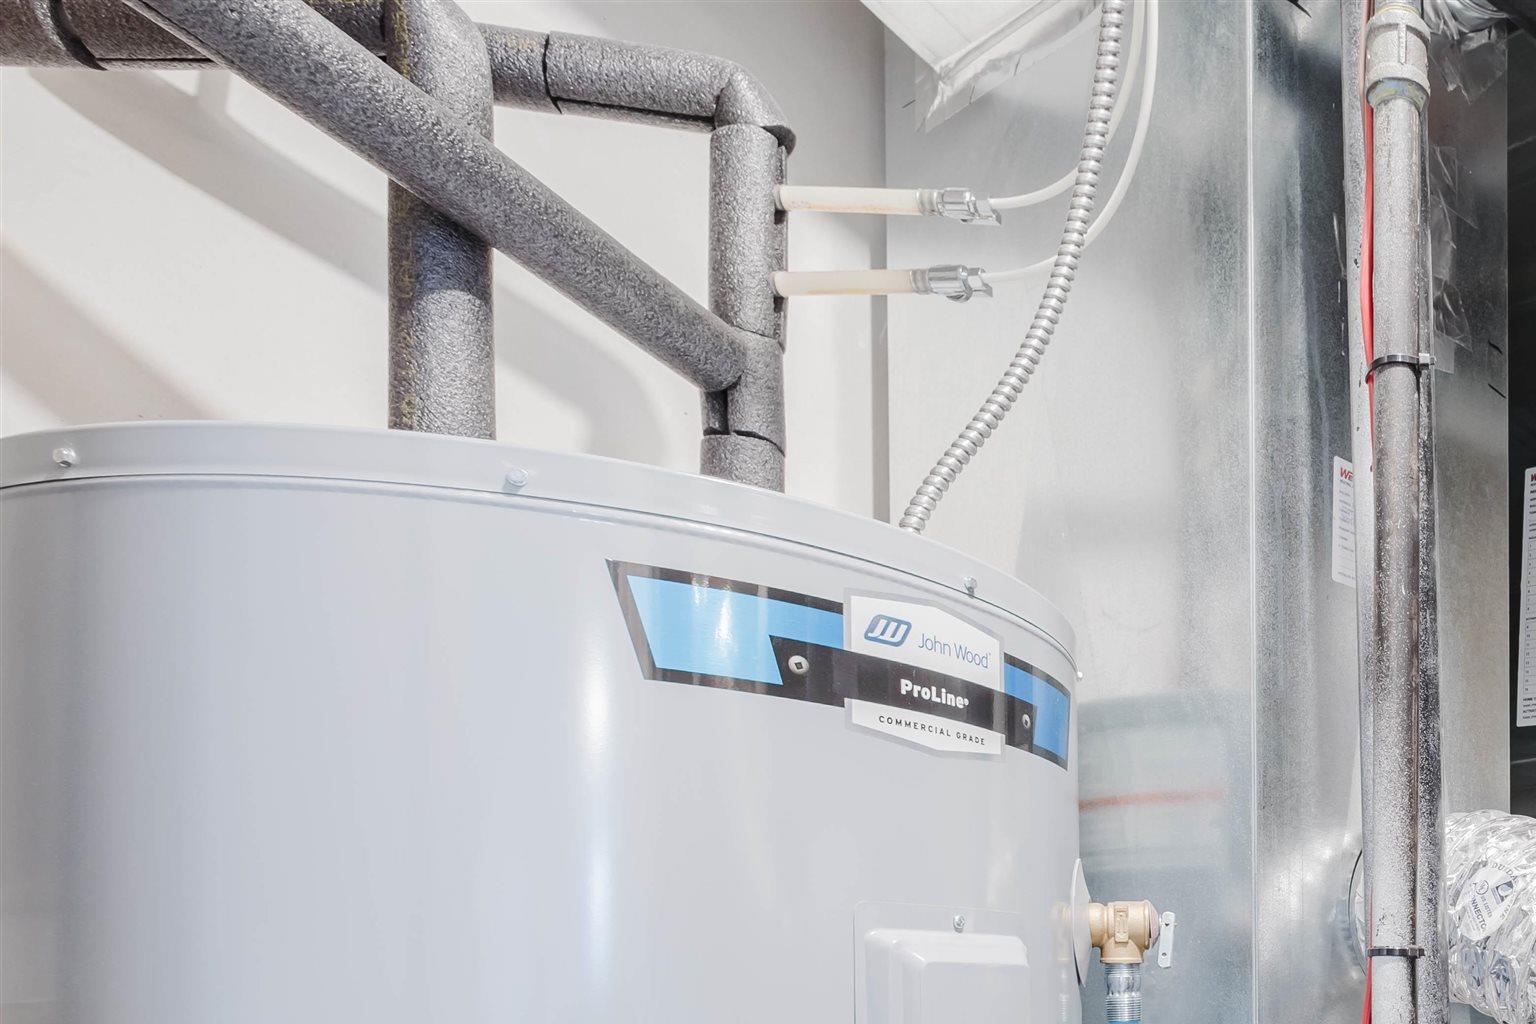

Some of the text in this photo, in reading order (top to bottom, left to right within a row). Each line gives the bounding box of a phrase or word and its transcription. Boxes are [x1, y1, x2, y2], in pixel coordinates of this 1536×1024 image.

[918, 633, 951, 657] John
[954, 642, 991, 669] Wood
[878, 715, 985, 746] COMMERCIAL GRADE
